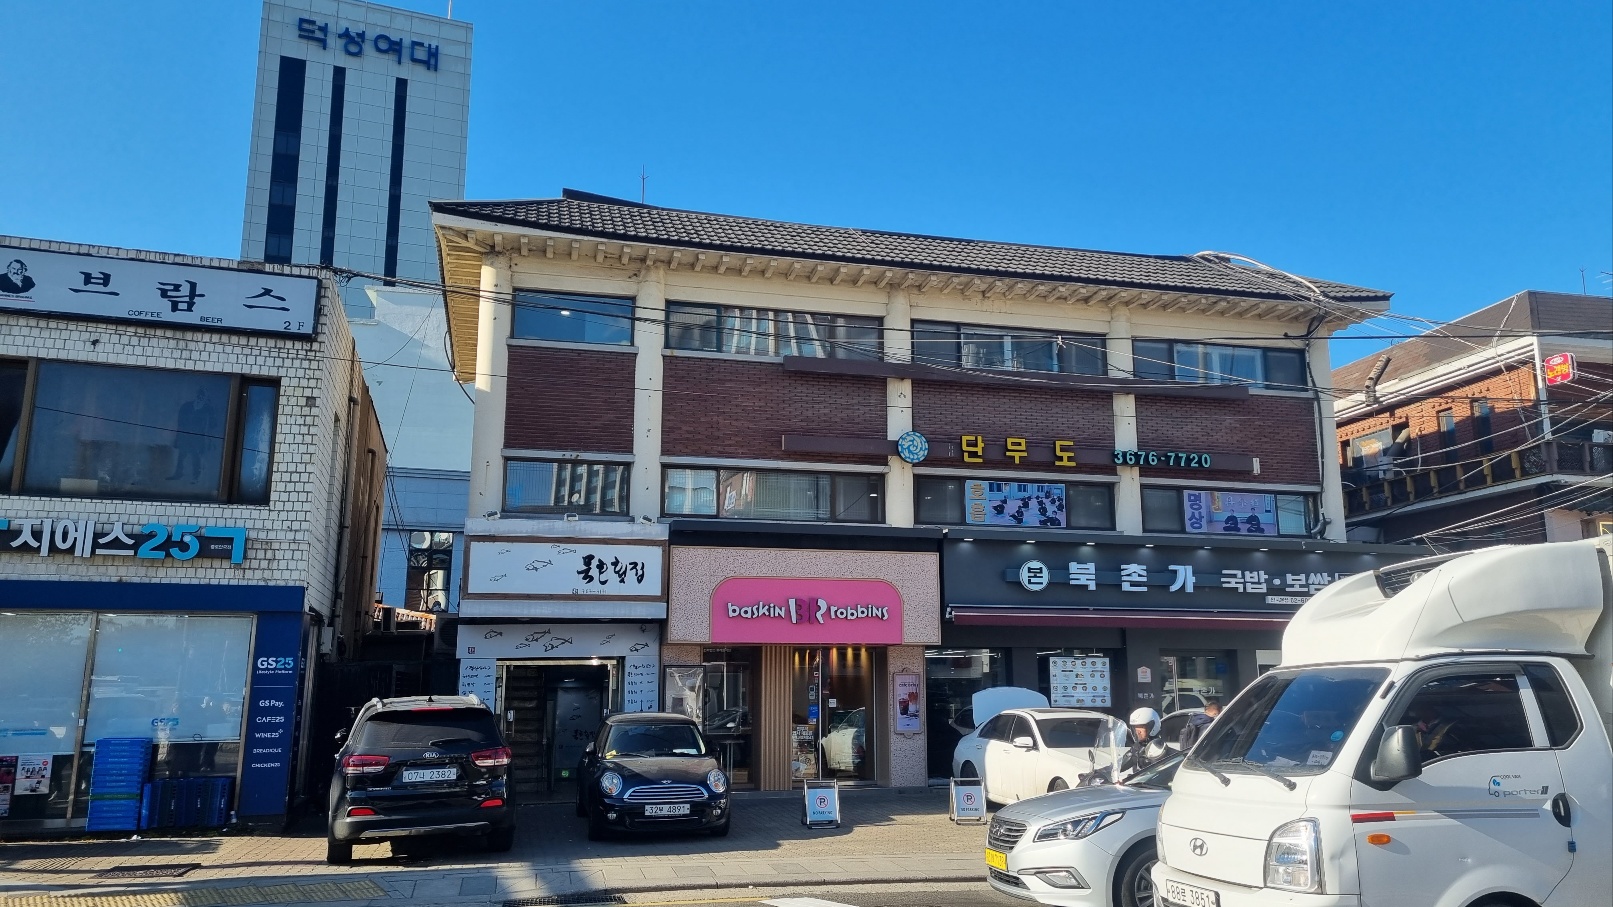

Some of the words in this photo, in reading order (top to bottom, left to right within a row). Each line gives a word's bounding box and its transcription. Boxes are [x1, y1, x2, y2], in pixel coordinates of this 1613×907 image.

[298, 17, 439, 71] 덕성여대
[68, 270, 291, 313] 브람스
[127, 309, 163, 318] COFFEE
[200, 315, 223, 324] BEER
[961, 435, 1077, 467] 단무도
[1114, 450, 1211, 468] 3676-7720
[1187, 492, 1205, 530] 명상
[9, 518, 200, 561] 지에스25
[1027, 566, 1044, 586] 본
[727, 601, 786, 619] baskin
[829, 604, 889, 621] robbins
[257, 657, 294, 669] GS25
[429, 769, 452, 780] 2382
[666, 804, 686, 814] 4891
[1189, 889, 1211, 907] 3851
